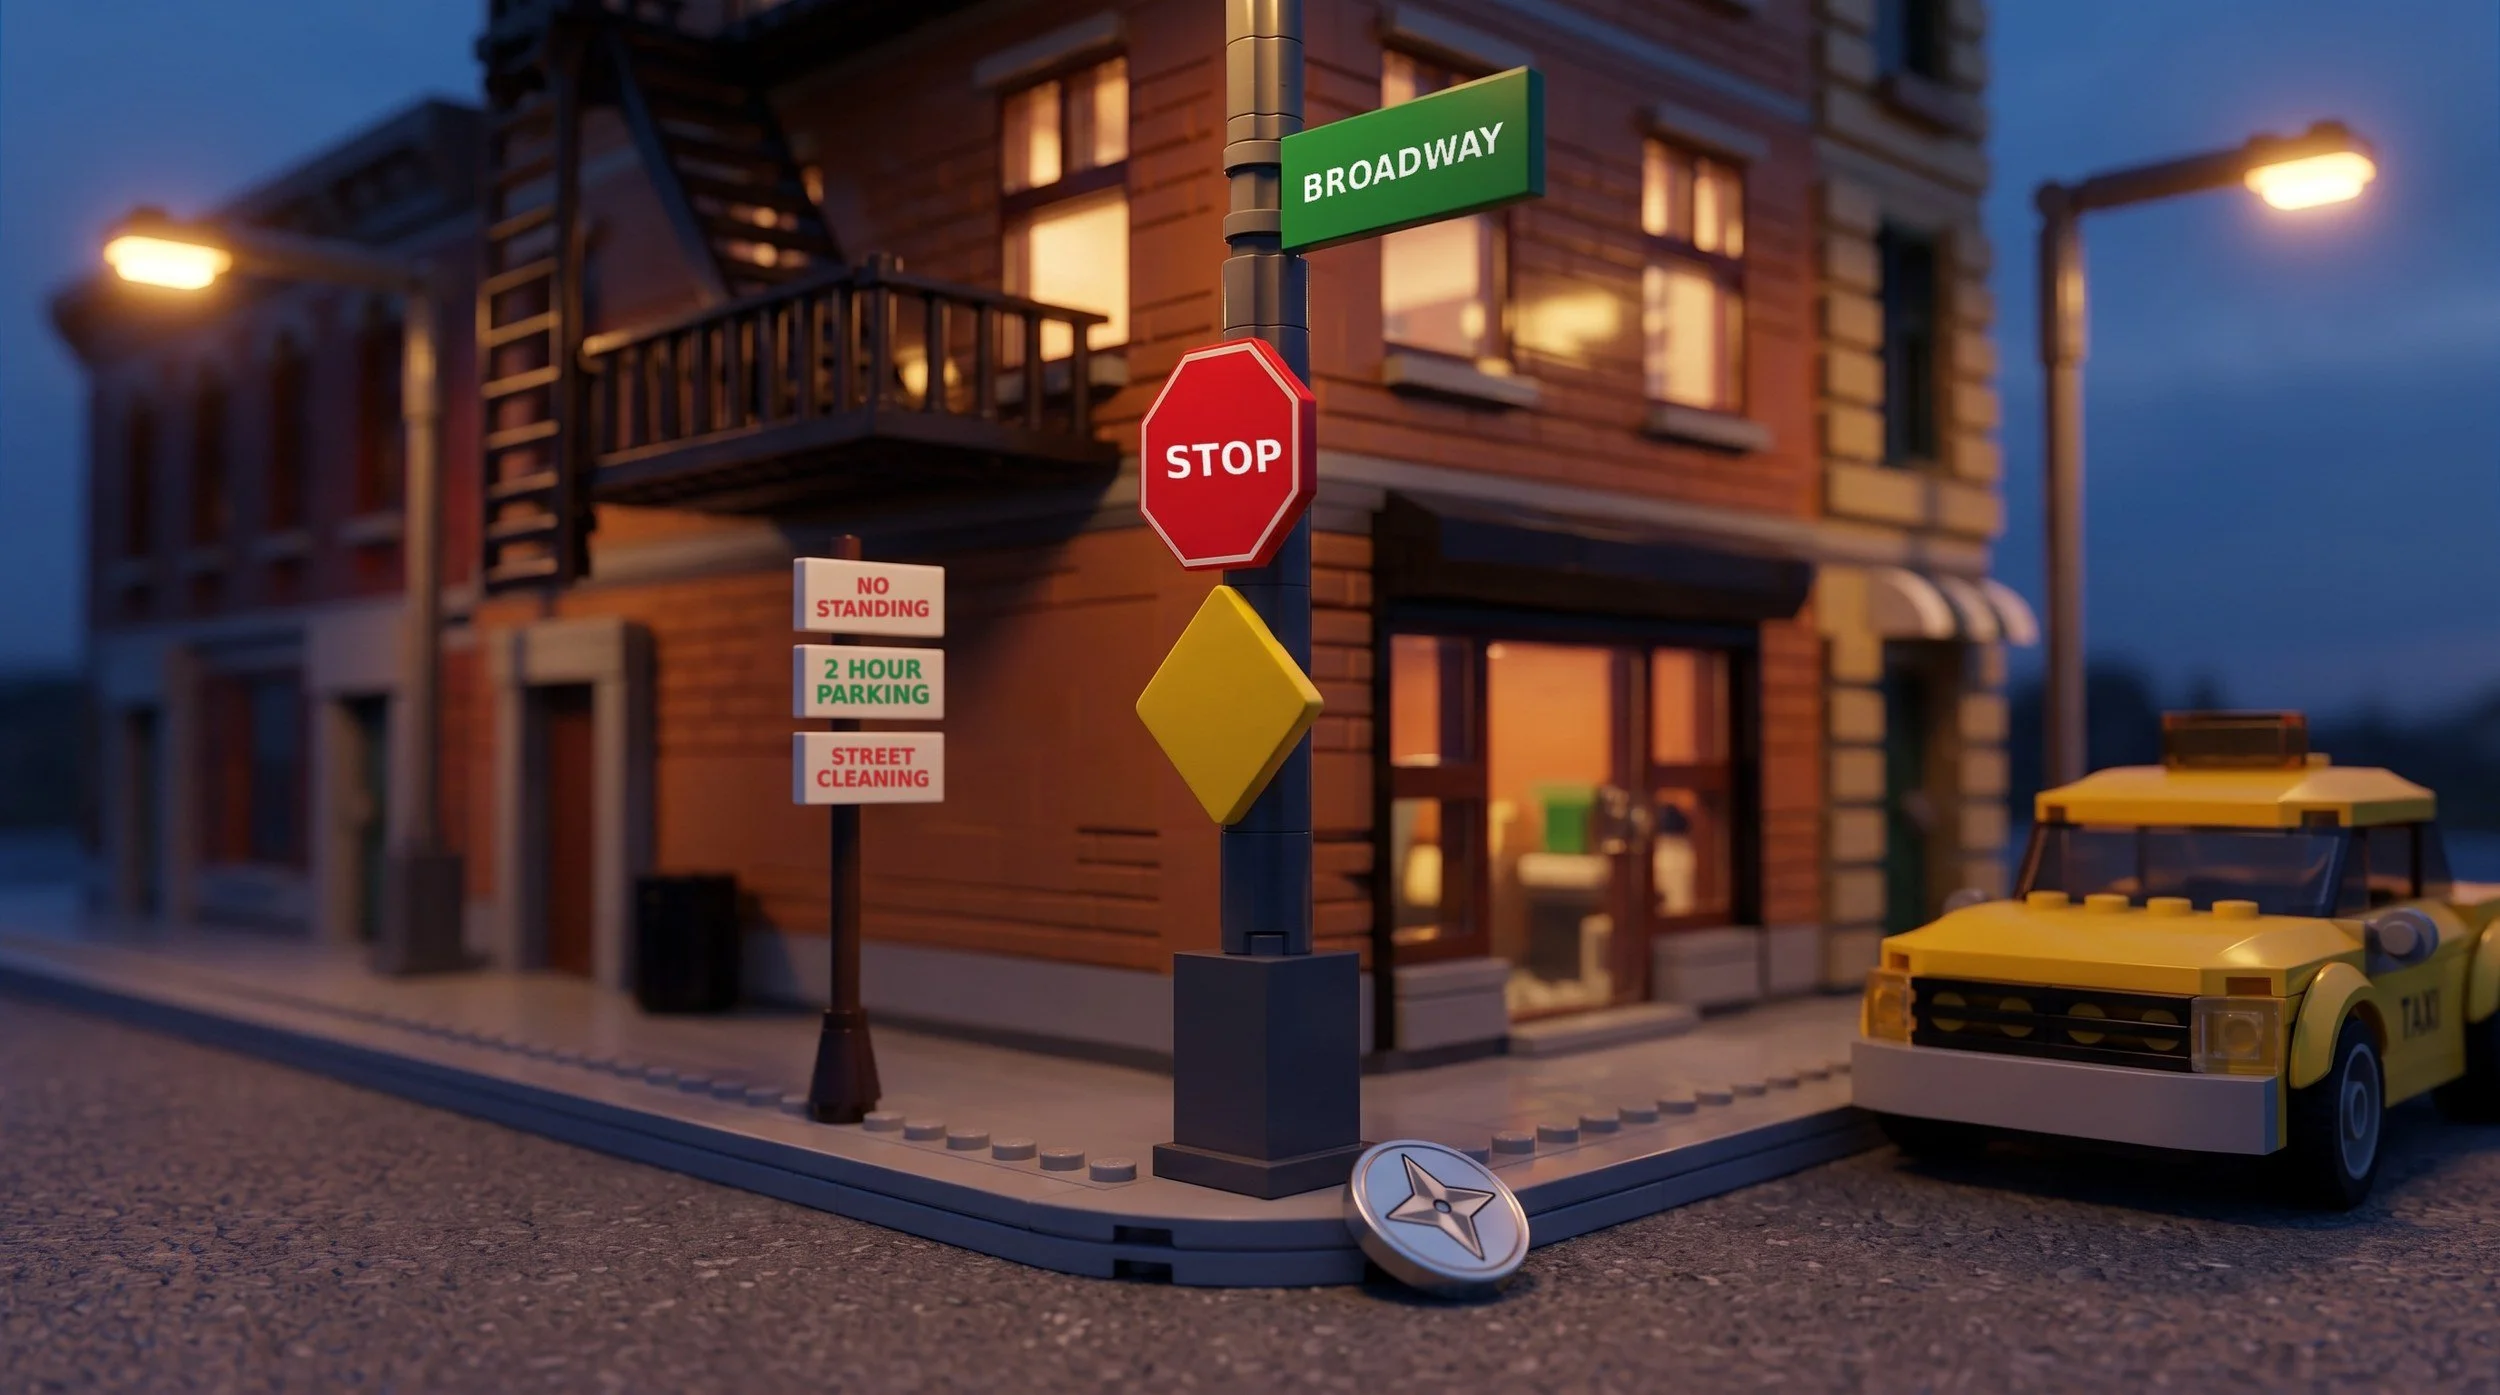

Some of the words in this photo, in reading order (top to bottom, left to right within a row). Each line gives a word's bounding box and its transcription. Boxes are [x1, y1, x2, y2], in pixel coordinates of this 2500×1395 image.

[1303, 122, 1504, 203] BROADWAY
[1166, 438, 1282, 480] STOP
[857, 577, 890, 595] NO
[816, 600, 930, 618] STANDING
[824, 659, 839, 679] 2
[848, 659, 922, 680] HOUR
[817, 684, 930, 705] PARKING
[831, 747, 916, 766] STREET
[816, 770, 930, 788] CLEANING
[2401, 988, 2440, 1039] TAXI
